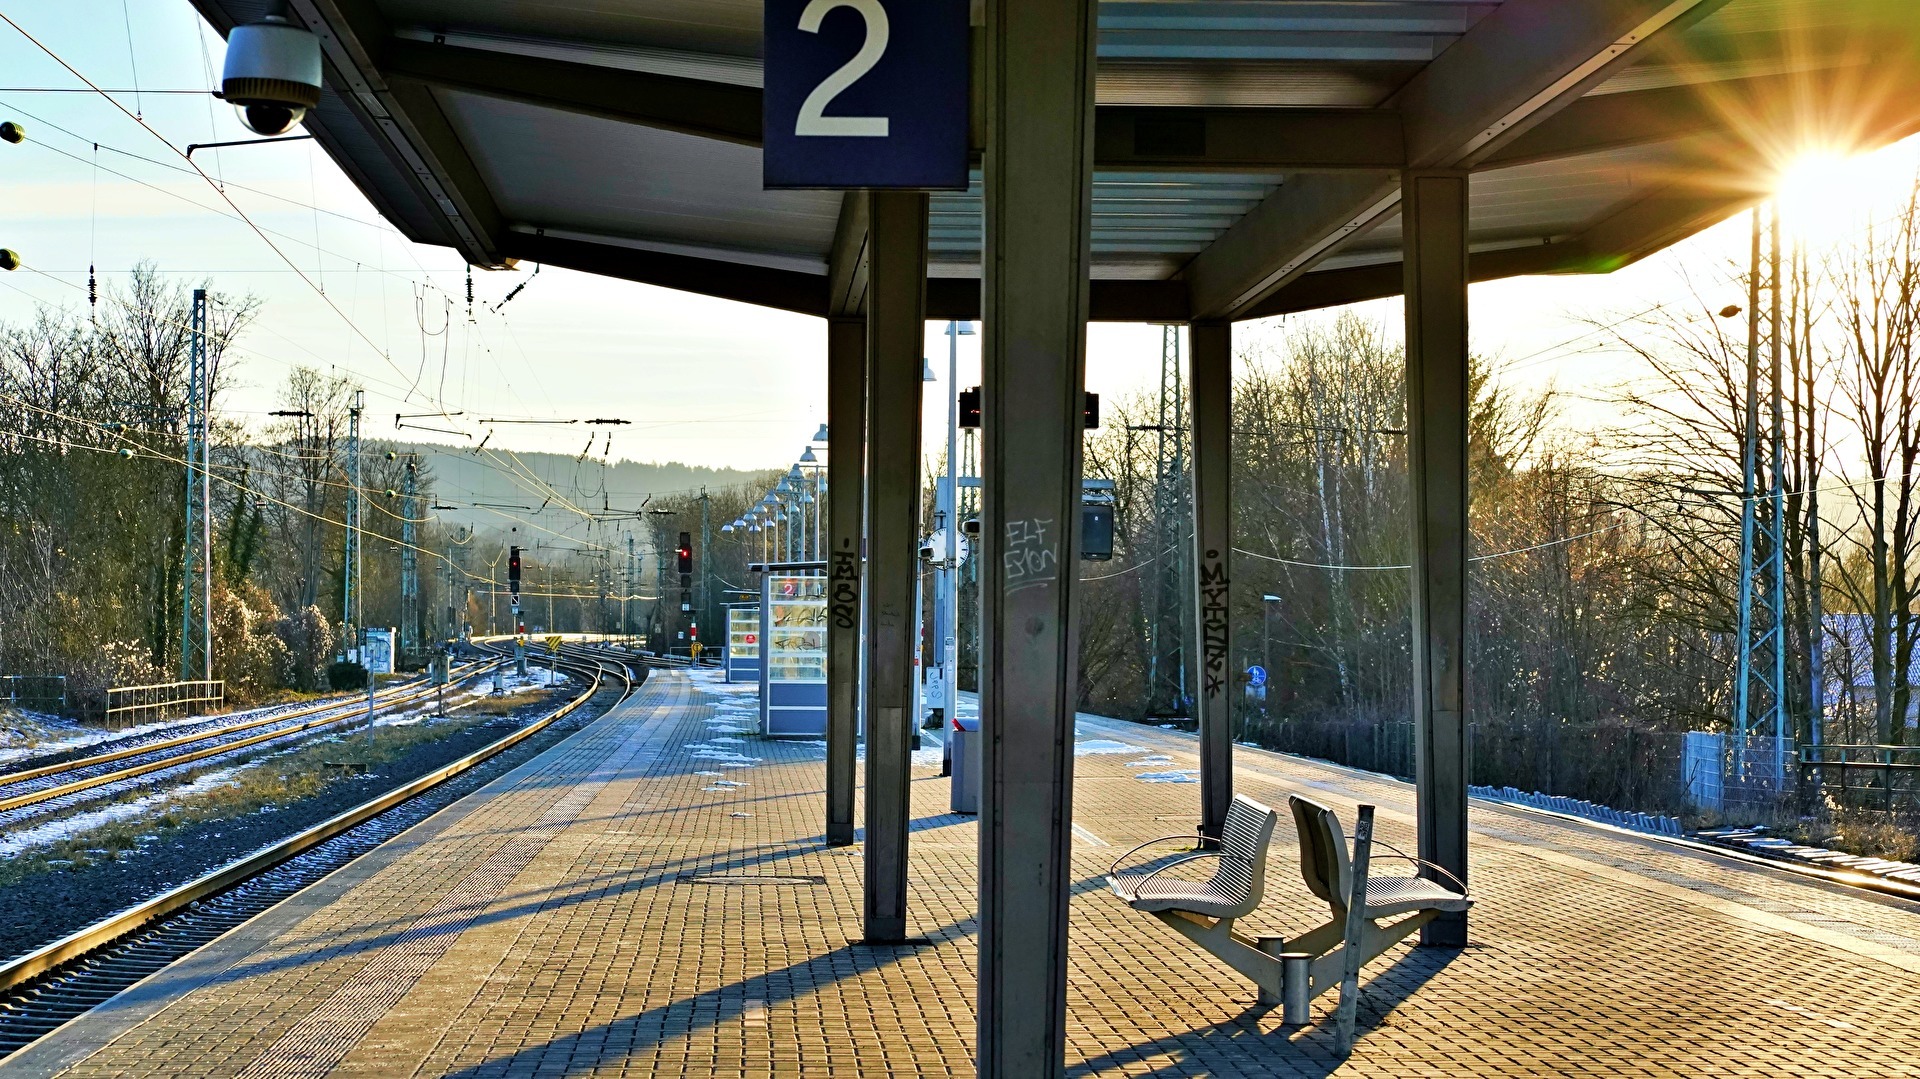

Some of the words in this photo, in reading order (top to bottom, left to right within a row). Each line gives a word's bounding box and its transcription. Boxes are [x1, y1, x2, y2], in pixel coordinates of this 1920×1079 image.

[795, 0, 890, 137] 2
[1005, 518, 1053, 546] ELF
[784, 583, 794, 596] 2
